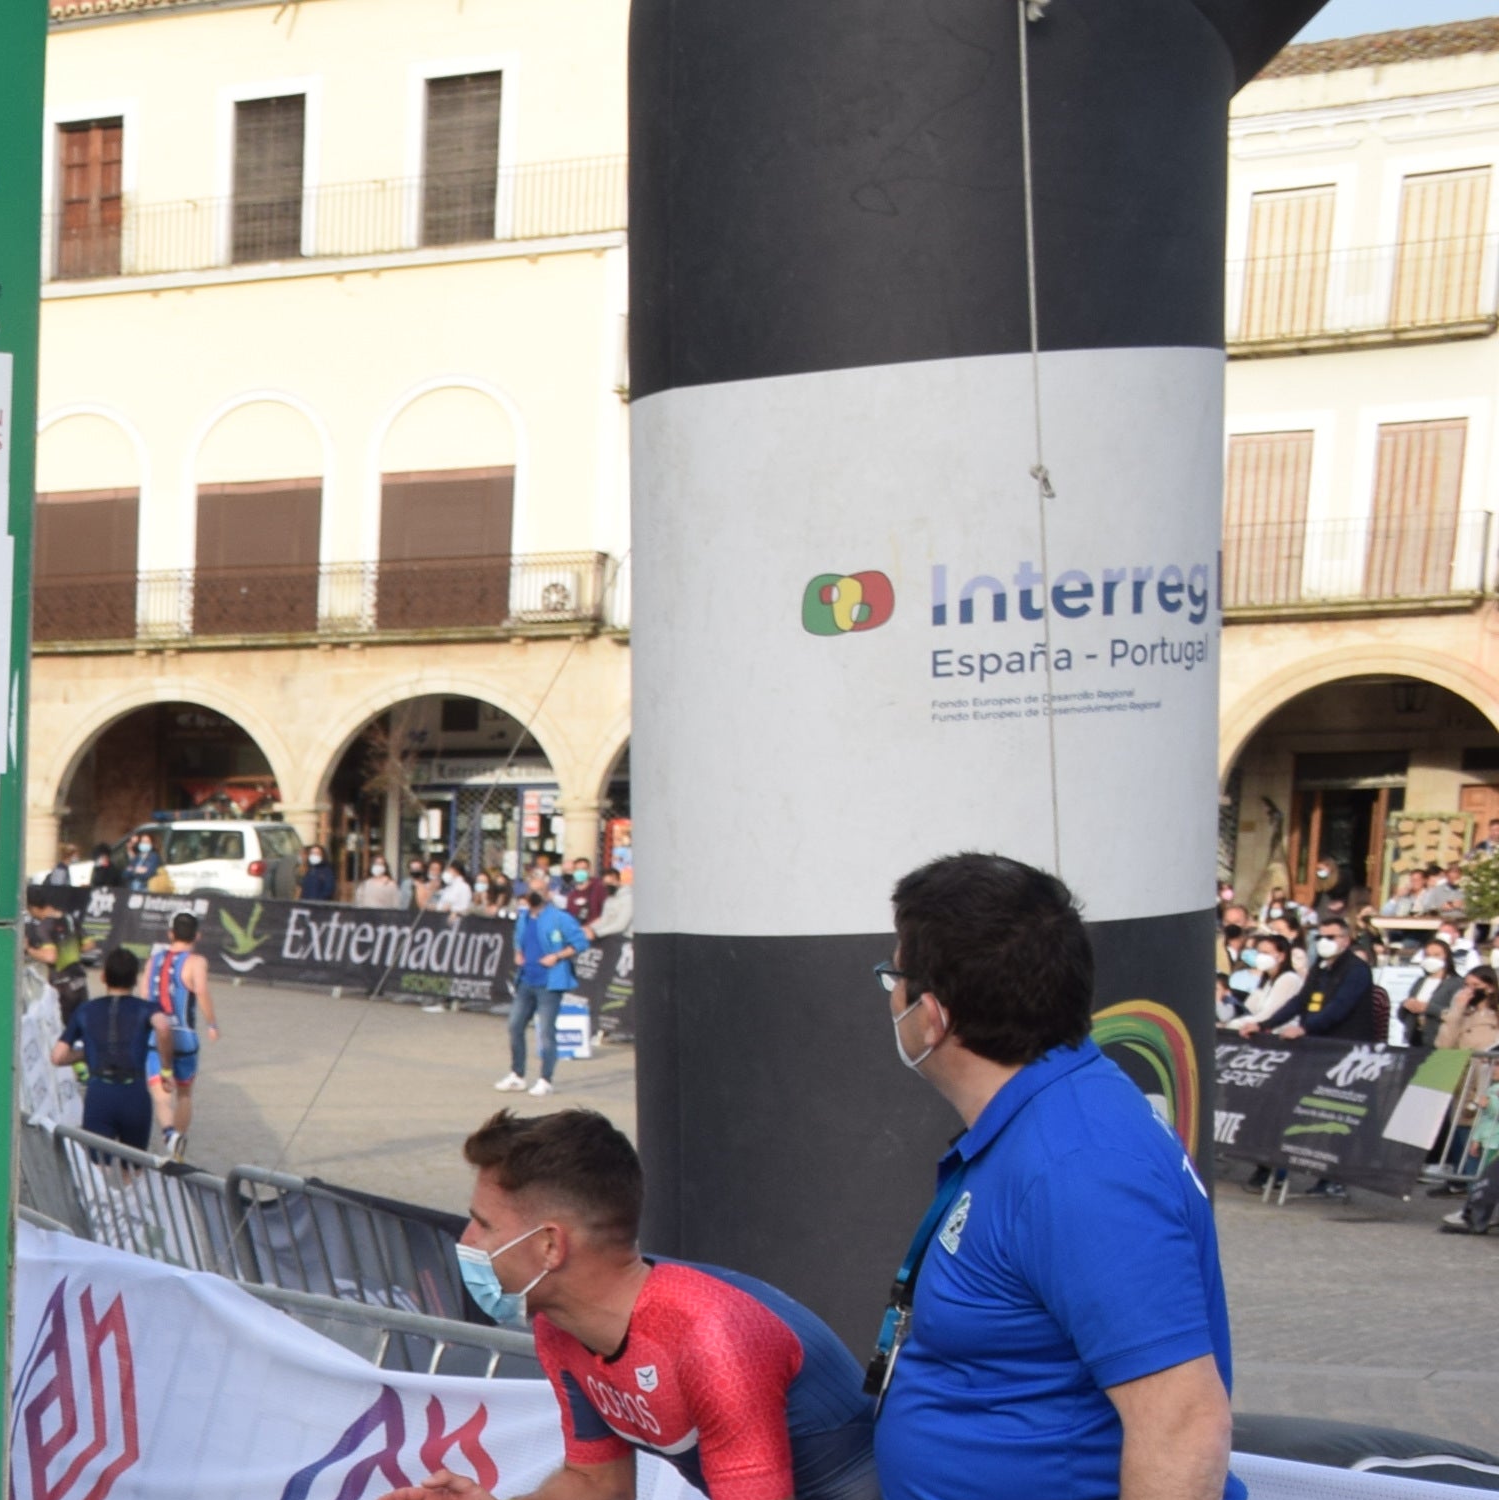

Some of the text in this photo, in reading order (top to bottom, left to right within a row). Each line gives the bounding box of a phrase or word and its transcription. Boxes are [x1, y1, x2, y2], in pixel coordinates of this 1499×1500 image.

[931, 559, 1210, 626] Interreg
[931, 641, 1073, 682] España
[1109, 634, 1209, 671] Portugal
[931, 698, 969, 710] Fondo
[972, 695, 1021, 709] Europeo
[1024, 695, 1039, 705] de
[931, 712, 970, 723] Fundo
[1025, 708, 1039, 718] de
[281, 907, 505, 981] Extremadura
